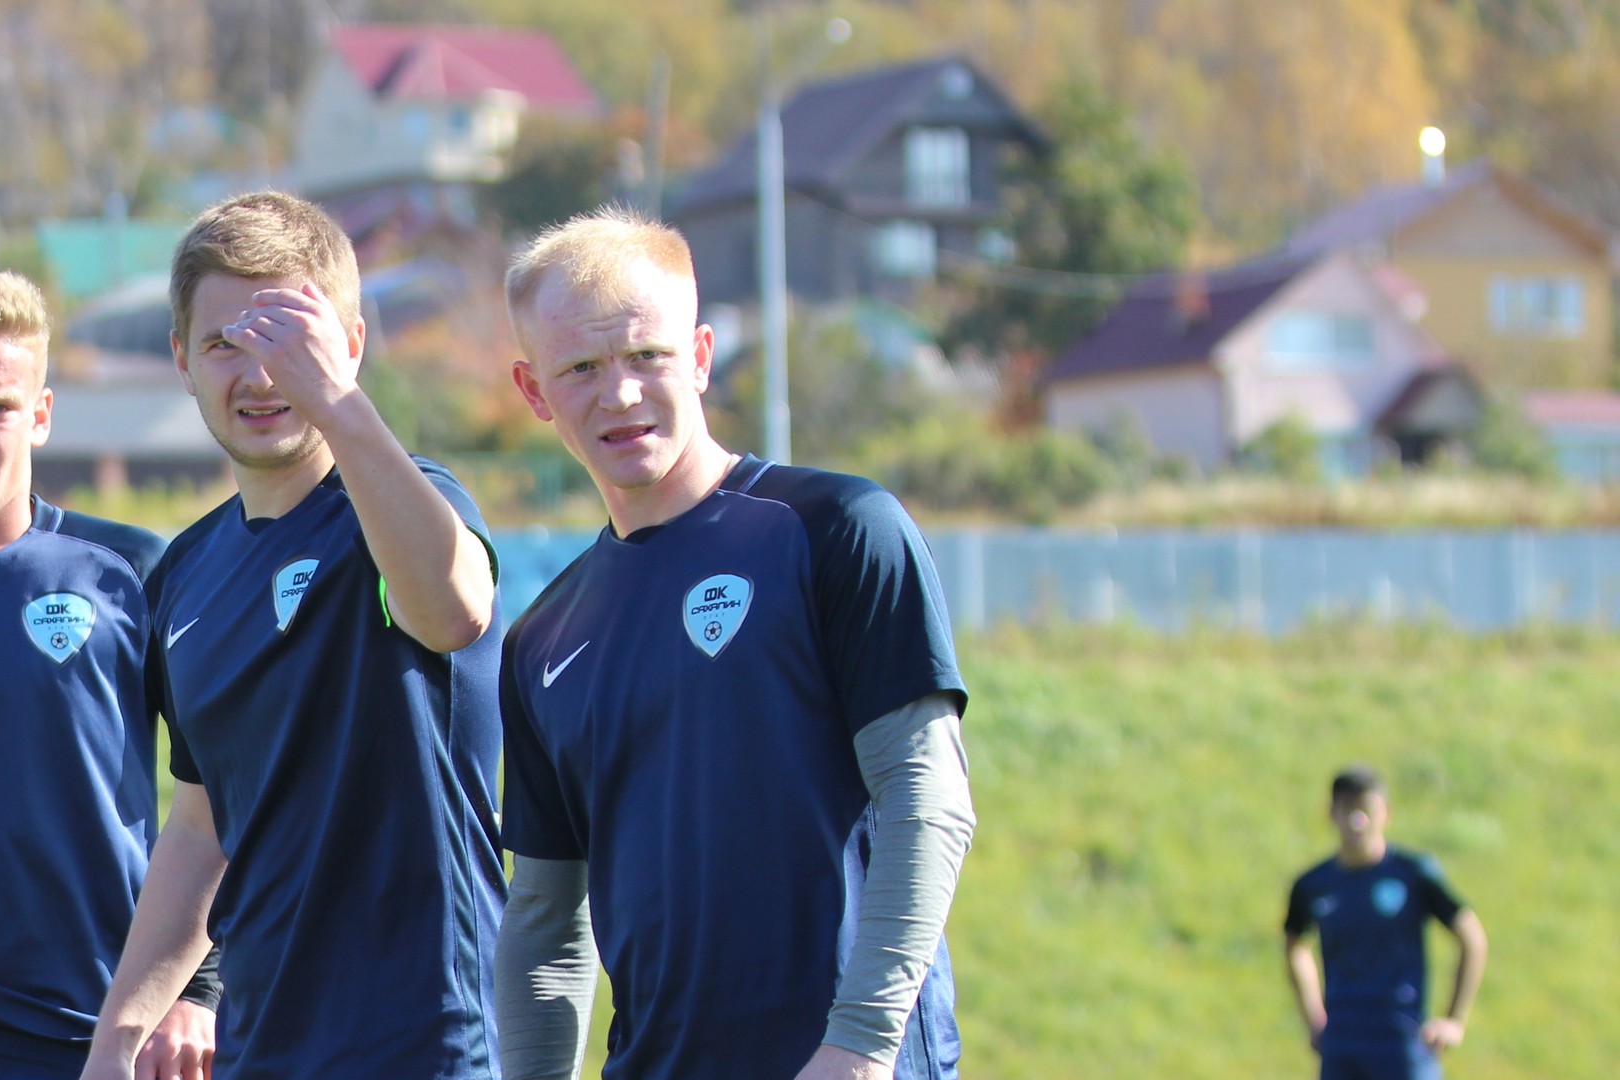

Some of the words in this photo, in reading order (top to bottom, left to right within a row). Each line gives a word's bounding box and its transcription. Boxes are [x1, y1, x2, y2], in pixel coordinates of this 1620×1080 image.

[293, 570, 314, 586] ФК
[704, 585, 728, 602] ФК
[46, 603, 71, 615] ФК
